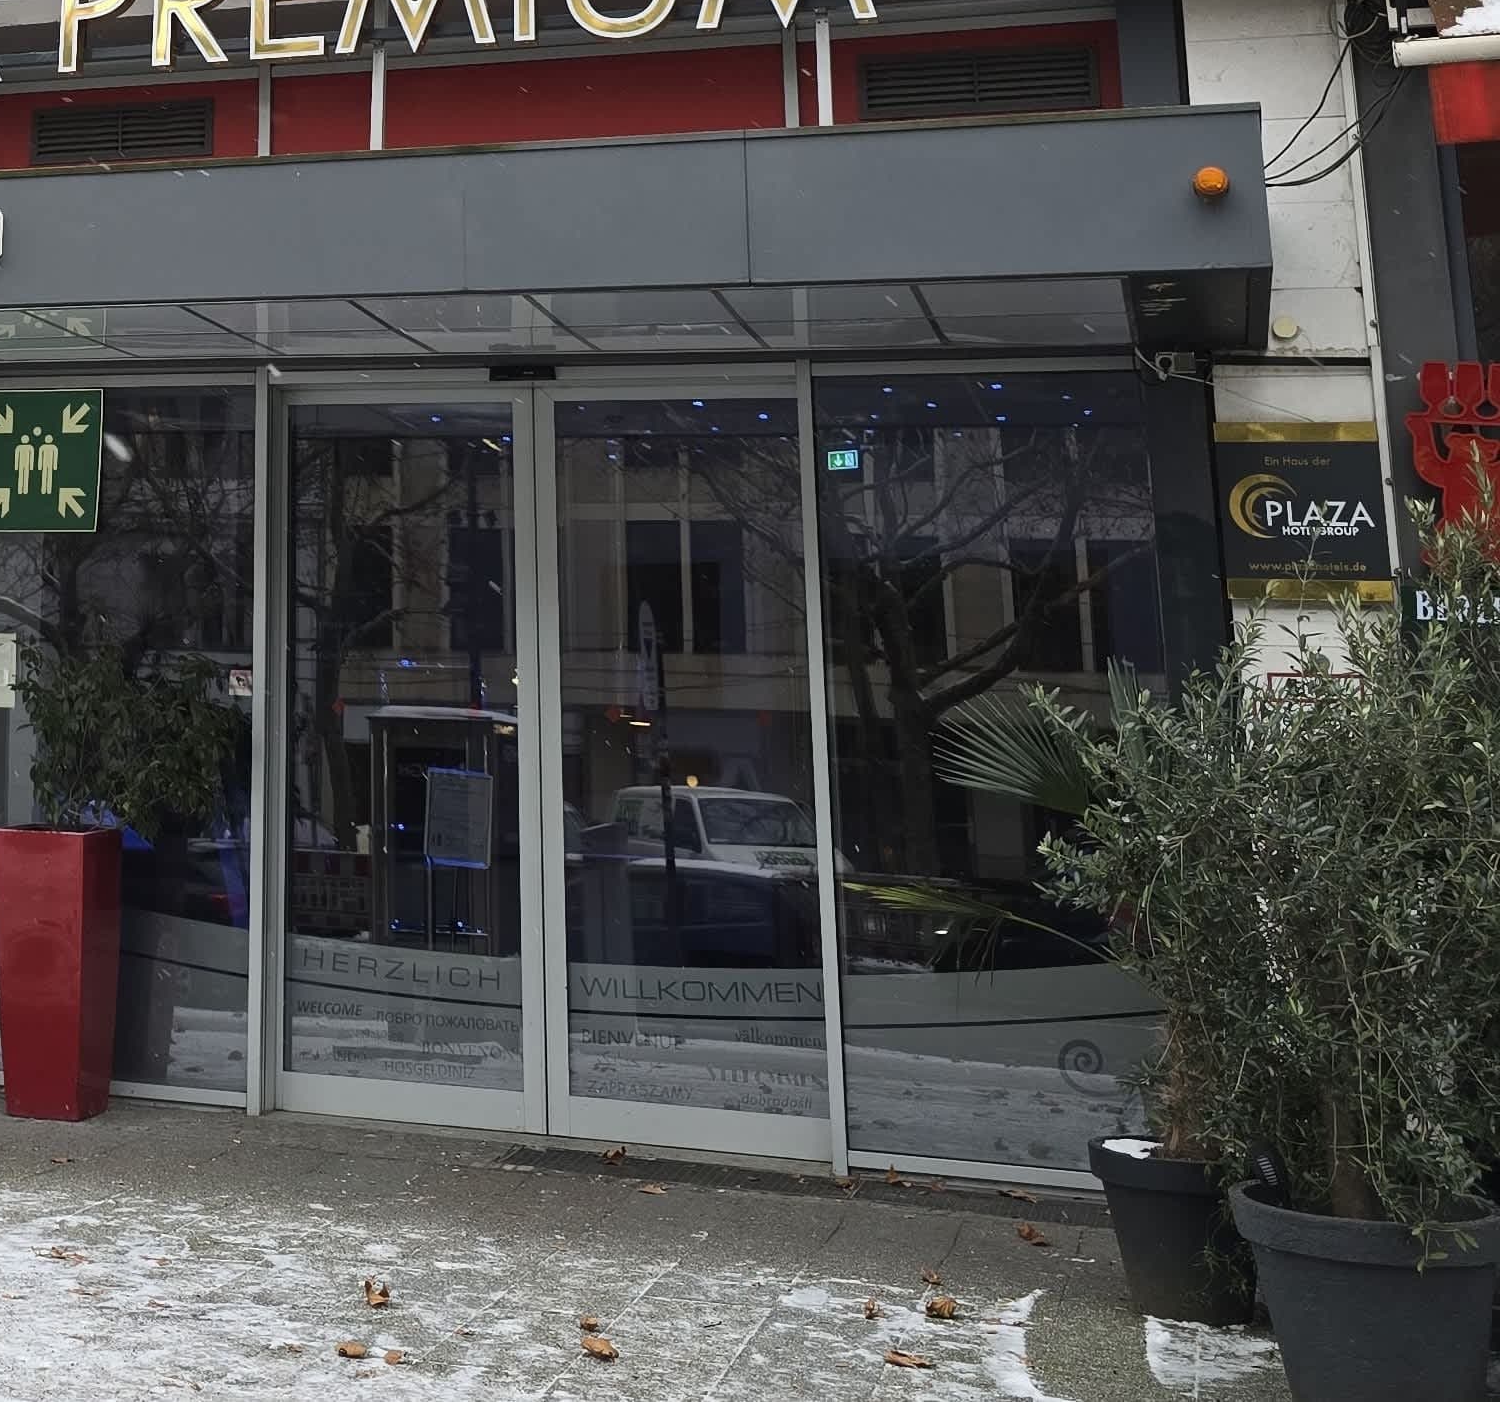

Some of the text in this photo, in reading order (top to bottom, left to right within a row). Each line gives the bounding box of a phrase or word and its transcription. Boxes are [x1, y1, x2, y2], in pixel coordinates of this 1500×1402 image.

[1264, 455, 1331, 467] Ein Haus der
[1265, 500, 1376, 528] PLAZA
[302, 948, 823, 1003] HERZLICH WILLKOMMEN
[298, 1000, 364, 1017] WELCOME
